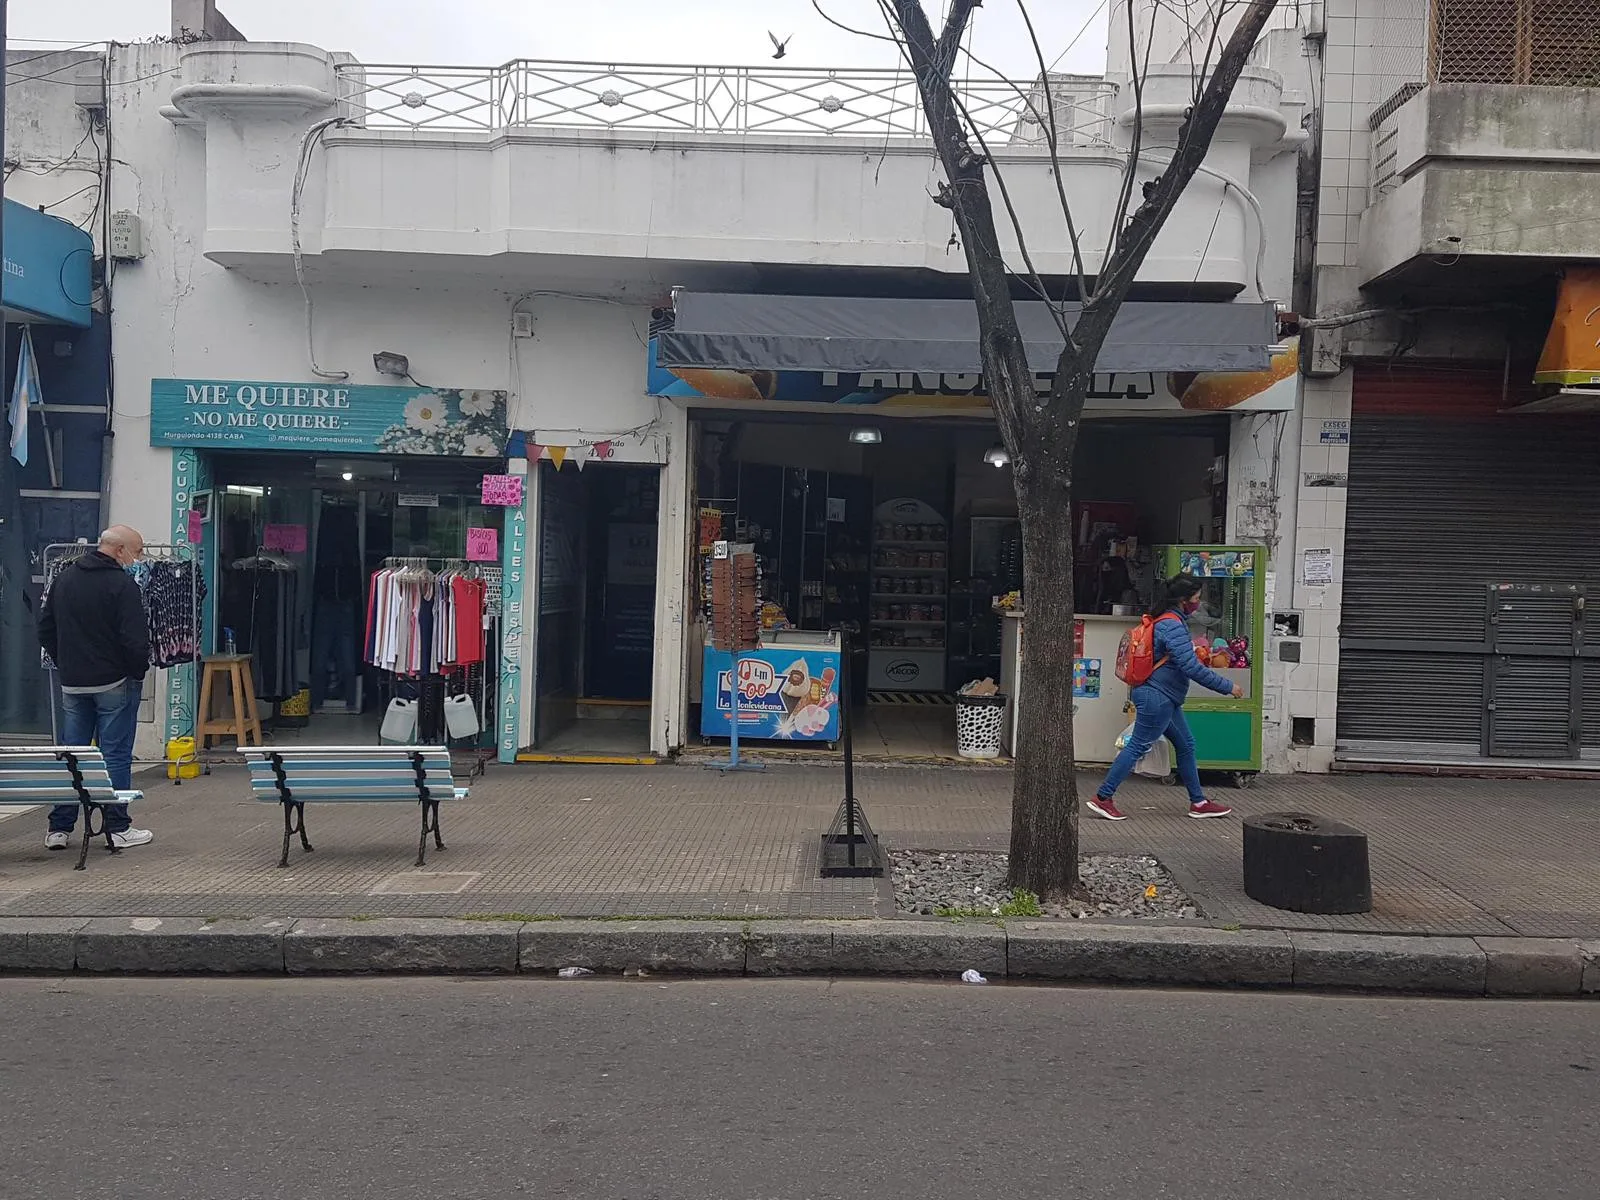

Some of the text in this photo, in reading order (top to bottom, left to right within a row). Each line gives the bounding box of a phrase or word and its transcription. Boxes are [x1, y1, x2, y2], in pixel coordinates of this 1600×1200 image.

[184, 384, 350, 410] ME QUIERE
[193, 411, 342, 431] NO ME QUIERE
[588, 448, 615, 458] 40
[503, 497, 526, 750] ALLES ESPECIALES
